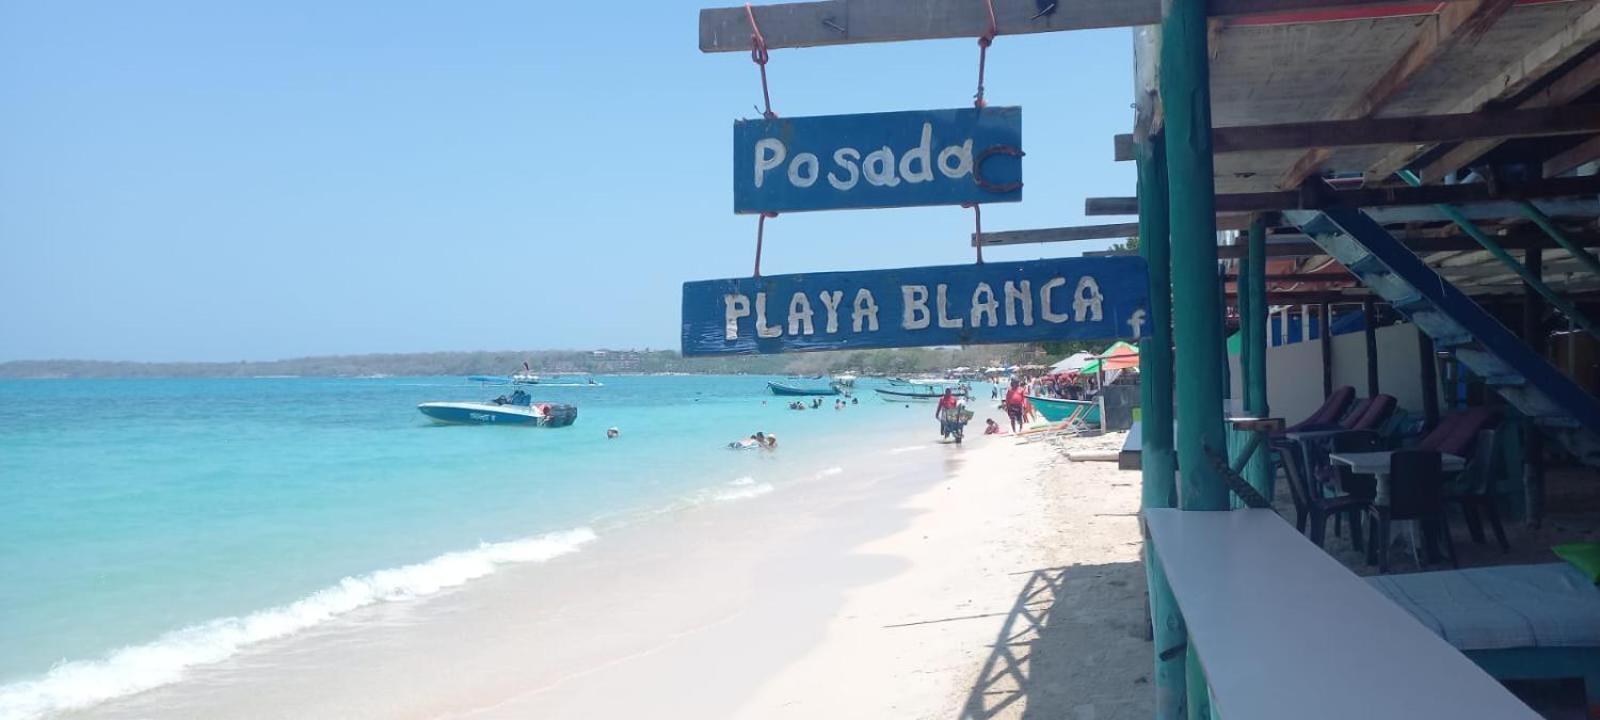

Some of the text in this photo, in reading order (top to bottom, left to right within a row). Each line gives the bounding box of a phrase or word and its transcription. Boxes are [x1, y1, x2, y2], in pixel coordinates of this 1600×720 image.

[753, 122, 974, 190] Posada
[725, 276, 1103, 341] PLAYA BLANCA
